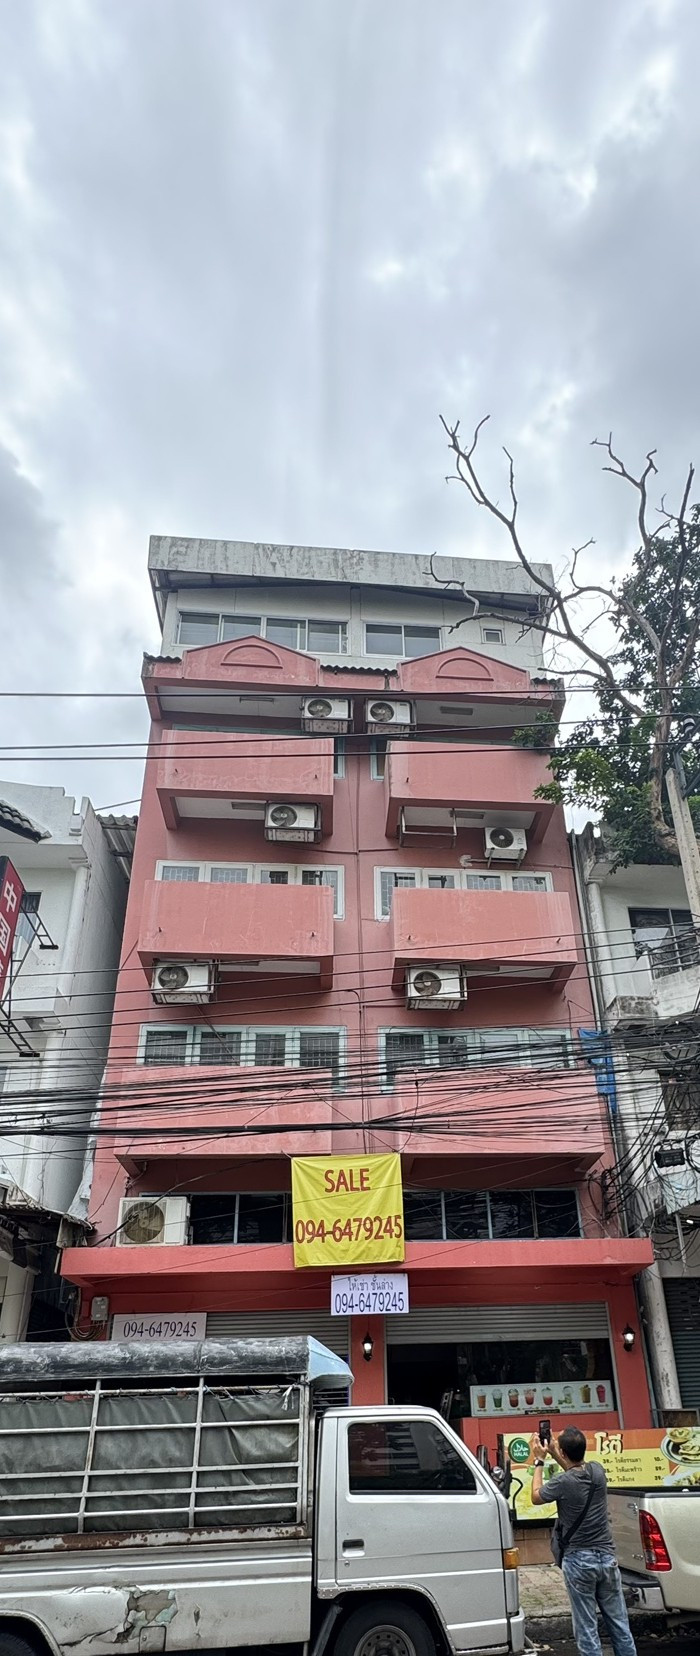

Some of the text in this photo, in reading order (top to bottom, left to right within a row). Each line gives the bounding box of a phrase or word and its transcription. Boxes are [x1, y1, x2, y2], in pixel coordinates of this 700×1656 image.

[324, 1168, 371, 1193] SALE
[295, 1215, 403, 1243] 094-6479245
[348, 1274, 393, 1291] ให้เช่า ชั้นล่าง
[335, 1291, 405, 1313] 094-6479245
[123, 1321, 197, 1337] 094-6479245
[594, 1432, 623, 1455] โรตี
